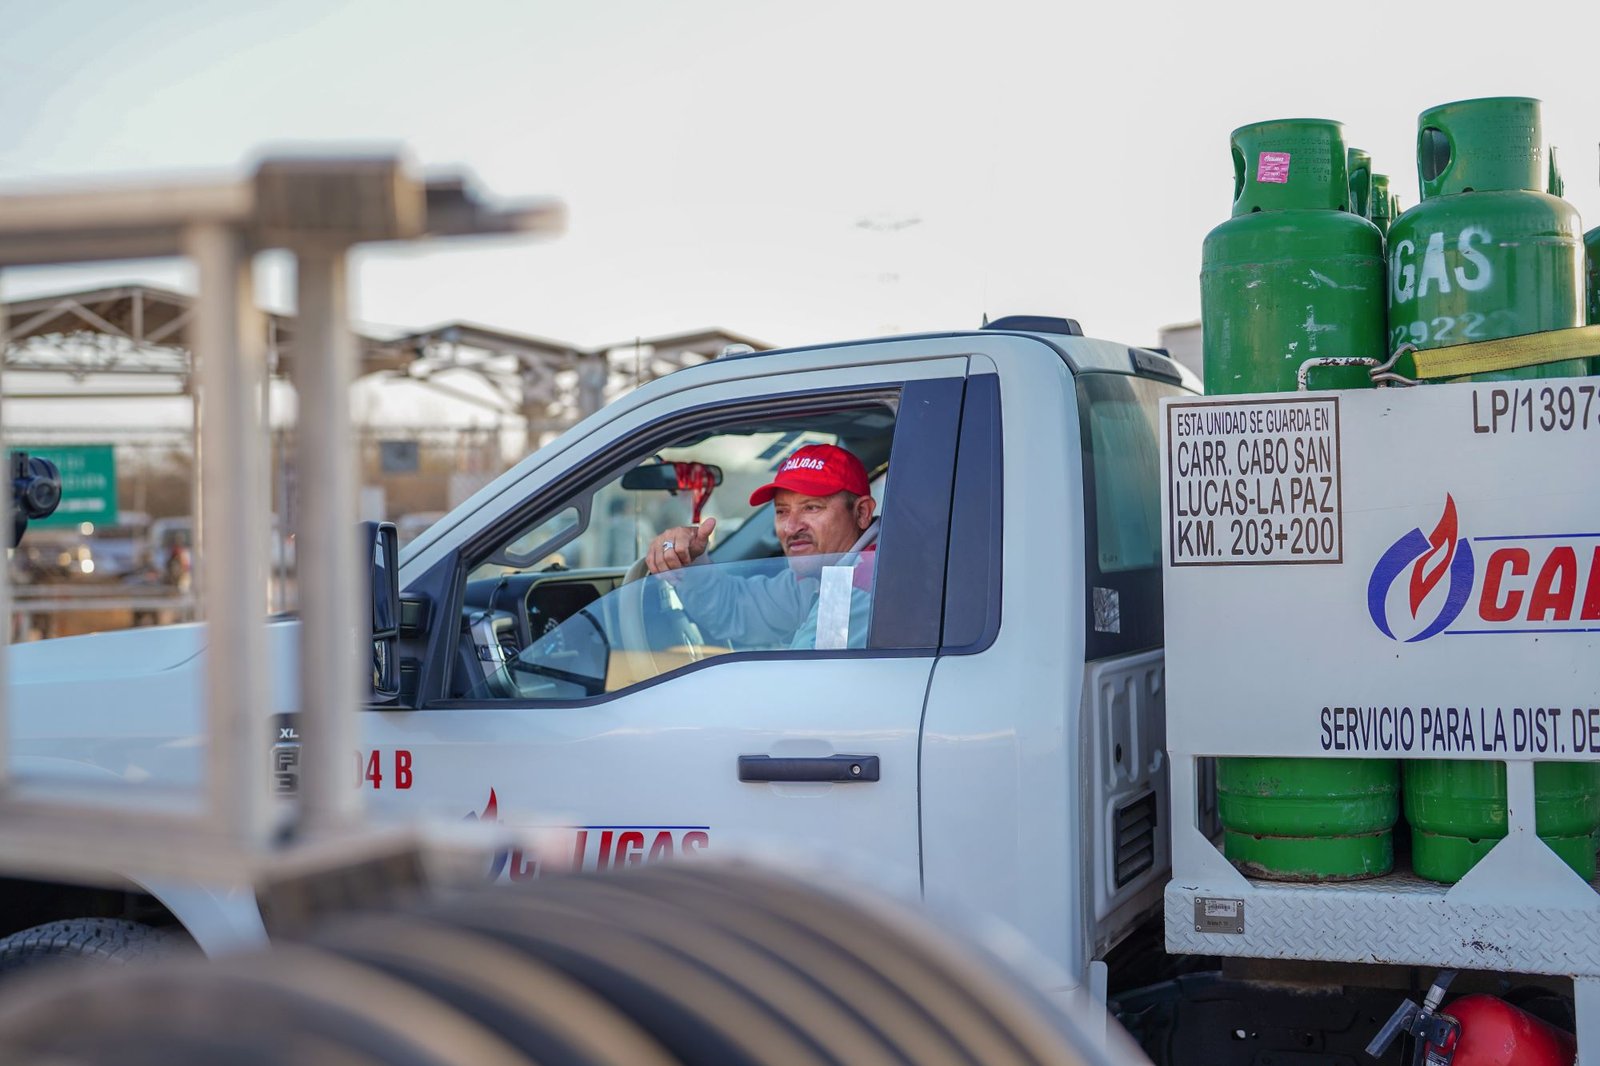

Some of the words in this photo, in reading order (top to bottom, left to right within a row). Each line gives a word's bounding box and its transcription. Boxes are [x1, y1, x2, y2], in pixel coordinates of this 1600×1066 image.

[1177, 413, 1204, 436] ESTA
[1206, 411, 1247, 435] UNIDAD
[1249, 410, 1263, 434] SE
[1266, 408, 1311, 433] GUARDA
[1314, 407, 1329, 431] EN
[1473, 386, 1600, 434] LP/1397
[1177, 440, 1232, 477] CARR.
[1237, 437, 1288, 475] CABO
[1294, 436, 1331, 473] SAN
[1176, 477, 1285, 516] LUCAS-LA
[1291, 476, 1334, 514] PAZ
[1178, 520, 1222, 556] KM.
[1231, 517, 1334, 555] 203+200
[279, 728, 299, 738] XL
[1320, 706, 1414, 751] SERVICIO
[1421, 707, 1475, 752] PARA
[1481, 707, 1507, 752] LA
[1513, 708, 1565, 753] DIST.
[1572, 708, 1600, 753] DE
[395, 750, 413, 789] B
